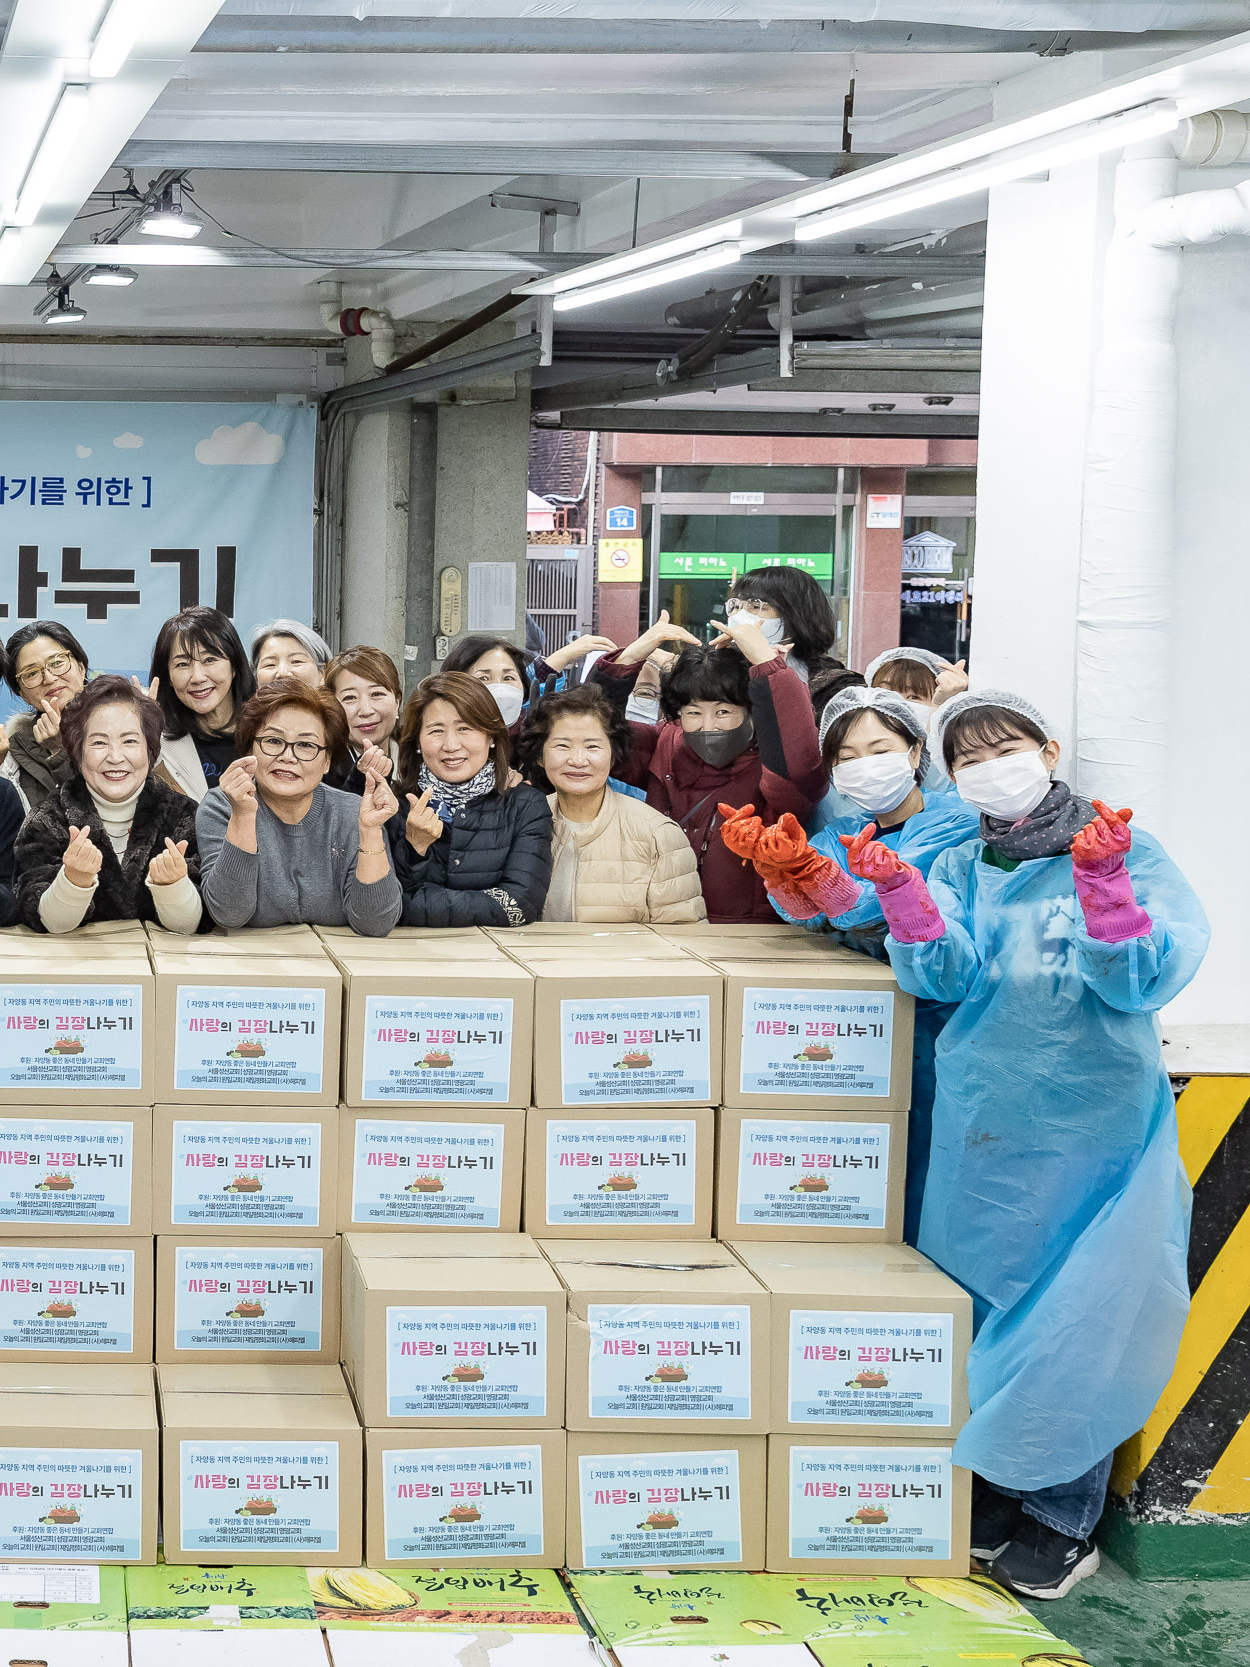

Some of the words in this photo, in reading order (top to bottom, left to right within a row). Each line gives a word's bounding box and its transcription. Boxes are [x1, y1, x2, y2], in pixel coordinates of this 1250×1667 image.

[75, 476, 133, 506] 위한
[616, 517, 628, 527] 14
[189, 1018, 231, 1032] 사랑의
[237, 1019, 315, 1034] 김장나누기
[377, 1028, 420, 1043] 사랑의
[426, 1029, 502, 1044] 김장나누기
[185, 1153, 228, 1167] 사랑의
[234, 1154, 311, 1169] 김장나누기
[367, 1152, 410, 1167] 사랑의
[416, 1154, 493, 1170] 김장나누기
[752, 1152, 795, 1167] 사랑의
[801, 1153, 879, 1169] 김장나누기
[188, 1279, 230, 1293] 사랑의
[236, 1279, 313, 1294] 김장나누기
[805, 1326, 826, 1334] 자양동
[828, 1326, 841, 1335] 지역
[843, 1326, 863, 1335] 주민의
[866, 1327, 885, 1335] 따뜻한
[887, 1327, 921, 1336] 겨울나기를
[923, 1328, 937, 1337] 위한
[400, 1341, 446, 1356] 사랑의
[453, 1341, 536, 1356] 김장나누기
[602, 1340, 649, 1355] 사랑의
[656, 1340, 740, 1356] 김장나누기
[803, 1345, 850, 1361] 사랑의
[857, 1346, 942, 1363] 김장나누기
[50, 1483, 131, 1499] 김장나누기
[397, 1482, 443, 1498] 사랑의
[449, 1480, 532, 1497] 김장나누기
[594, 1488, 640, 1505] 사랑의
[647, 1485, 729, 1503] 김장나누기
[804, 1482, 850, 1497] 사랑의
[857, 1483, 941, 1498] 김장나누기
